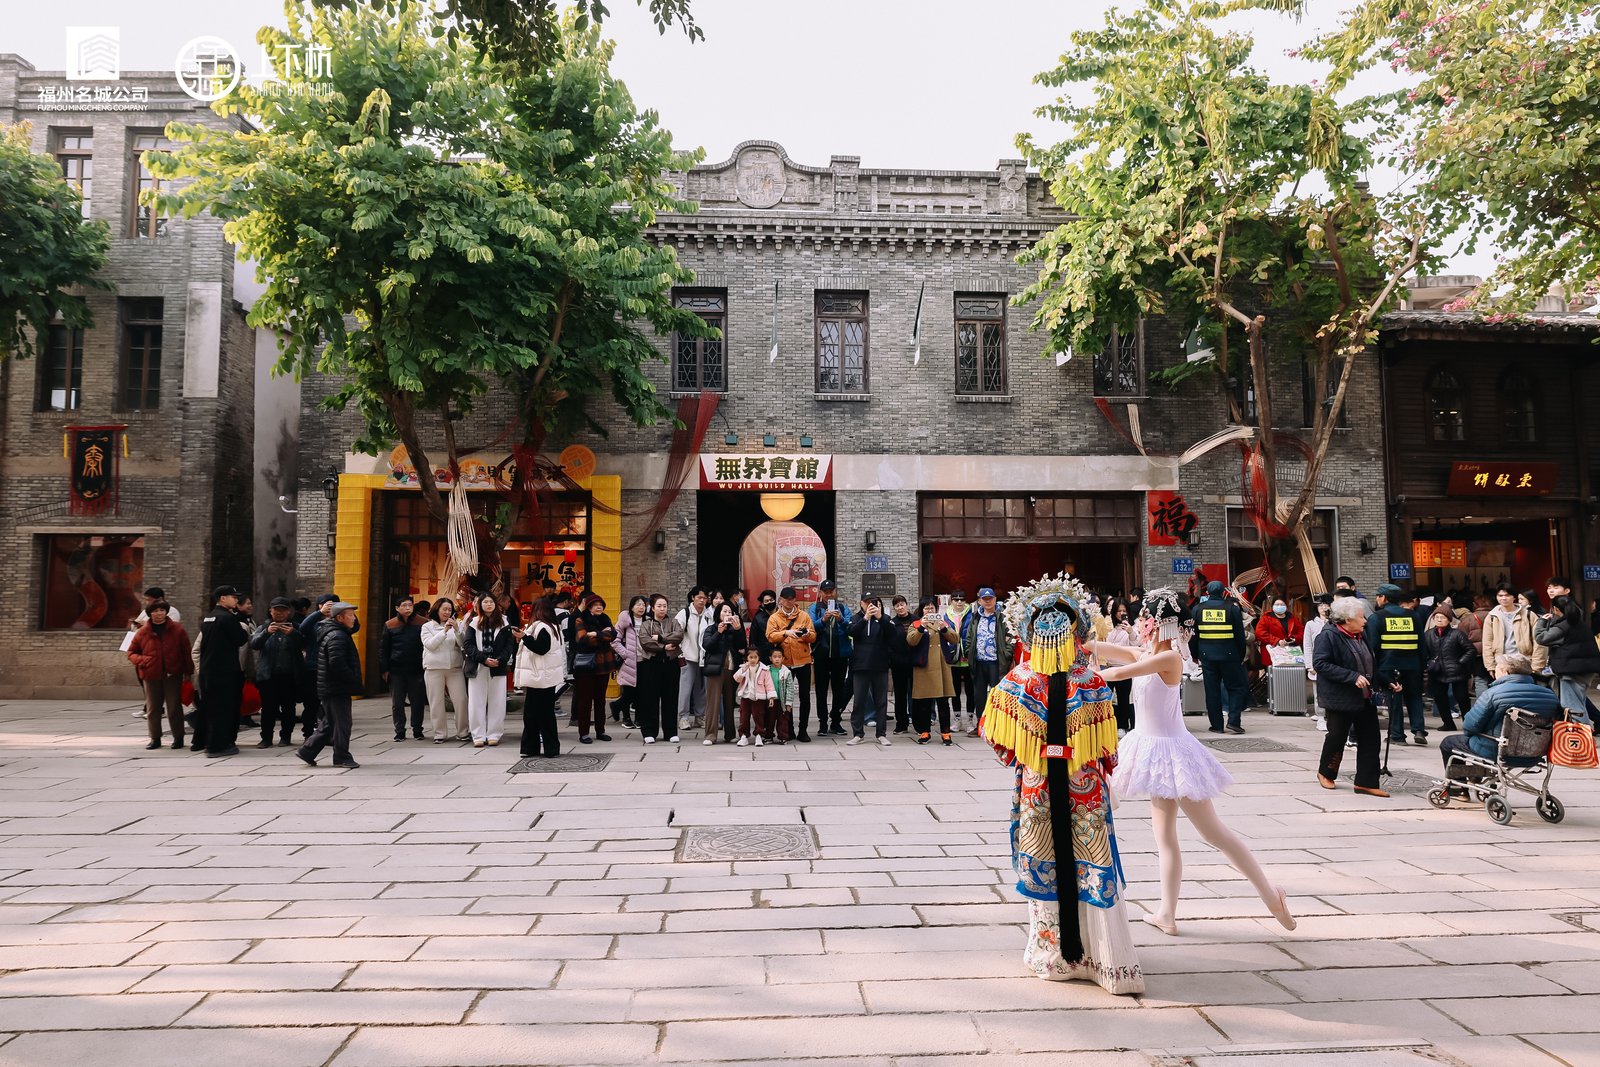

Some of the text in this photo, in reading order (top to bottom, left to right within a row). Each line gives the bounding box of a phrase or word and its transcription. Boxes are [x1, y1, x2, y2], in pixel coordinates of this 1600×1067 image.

[715, 456, 820, 481] 無界會館
[718, 482, 733, 490] WU
[738, 482, 752, 490] JIE
[791, 482, 814, 490] HALL
[1151, 497, 1196, 542] 福
